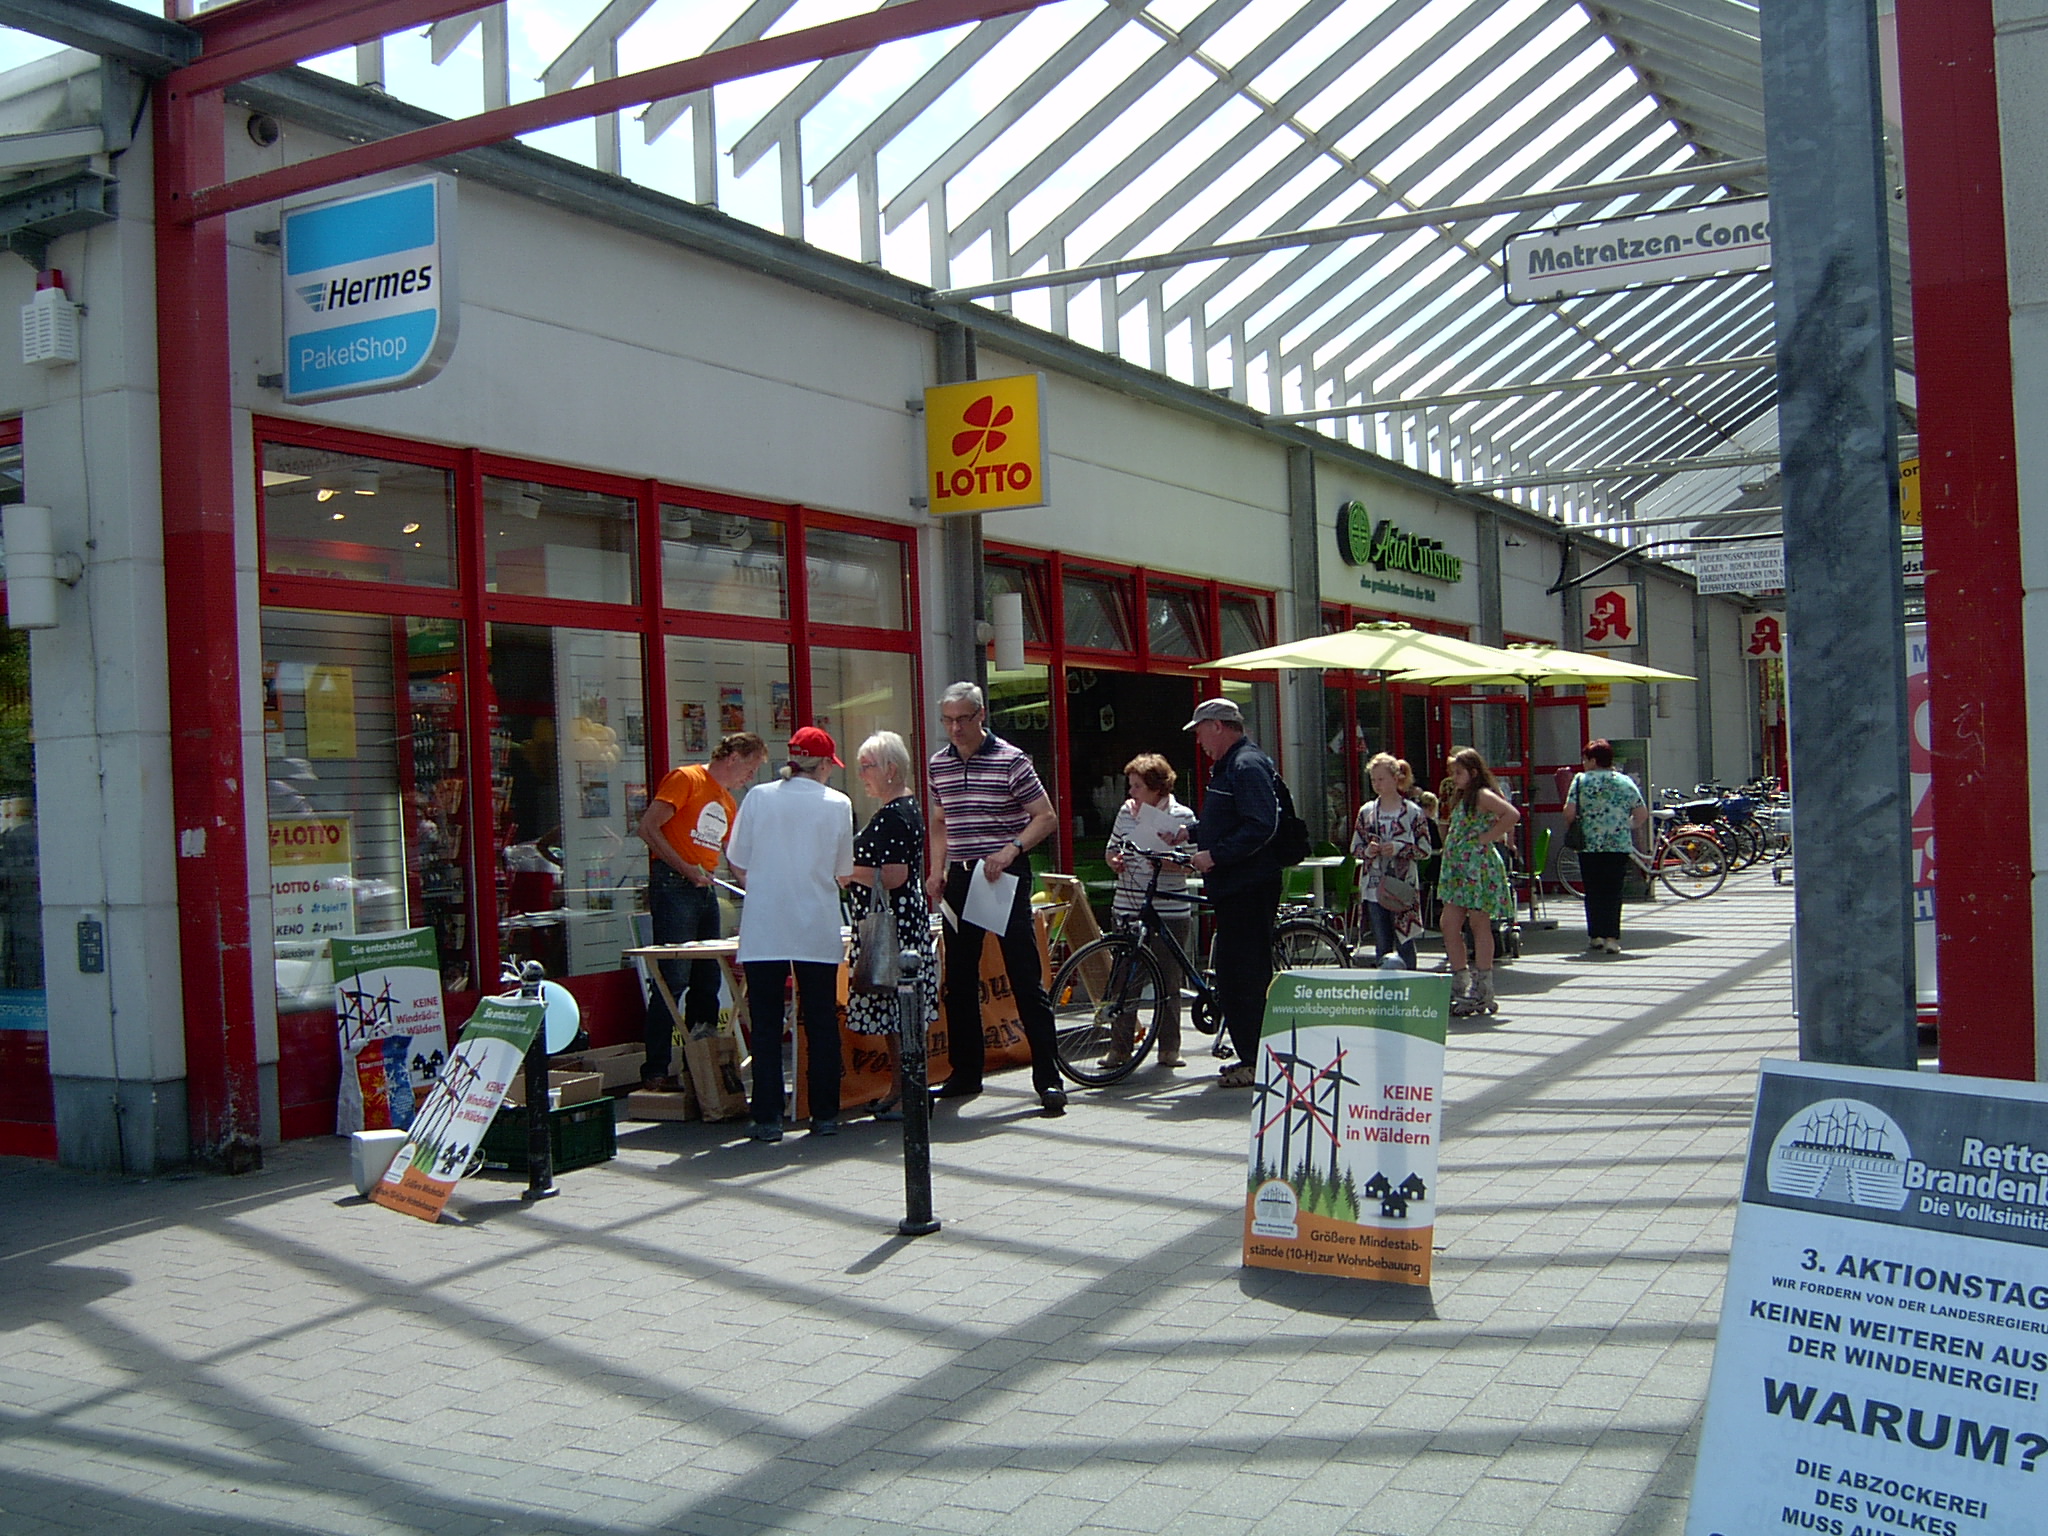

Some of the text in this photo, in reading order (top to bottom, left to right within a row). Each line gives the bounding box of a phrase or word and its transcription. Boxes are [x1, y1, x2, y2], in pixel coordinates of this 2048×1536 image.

[328, 265, 432, 310] Hermes
[302, 337, 407, 371] PaketShop
[936, 462, 1032, 498] LOTTO
[284, 824, 341, 846] LOTTO
[276, 881, 310, 894] LOTTO
[276, 923, 304, 936] KENO
[413, 996, 438, 1008] KEINE
[1294, 985, 1410, 1001] Sie entscheiden!
[1272, 1004, 1438, 1018] www.volksbegehren-windkraft.de
[1384, 1085, 1433, 1101] KEINE
[1349, 1104, 1432, 1124] Windräder
[1347, 1126, 1430, 1145] in Wäldern
[1920, 1196, 1950, 1216] Die
[1311, 1231, 1423, 1252] Größere Mindestab-
[1250, 1245, 1284, 1258] stände
[1338, 1253, 1421, 1275] Wohnbebauung
[1801, 1248, 2048, 1310] 3. AKTIONSTAG
[1772, 1276, 1796, 1290] WIR
[1800, 1281, 1861, 1301] FORDERN
[1866, 1293, 1894, 1307] VON
[1898, 1298, 1926, 1313] DER
[1750, 1300, 2048, 1372] KEINEN WEITEREN AUS
[1788, 1335, 2039, 1402] DER WINDENERGIE!
[1763, 1376, 2048, 1473] WARUM?
[1795, 1458, 1987, 1520] DIE ABZOCKEREI
[1782, 1506, 1843, 1536] MUSS
[1815, 1489, 1958, 1536] DES VOLKES
